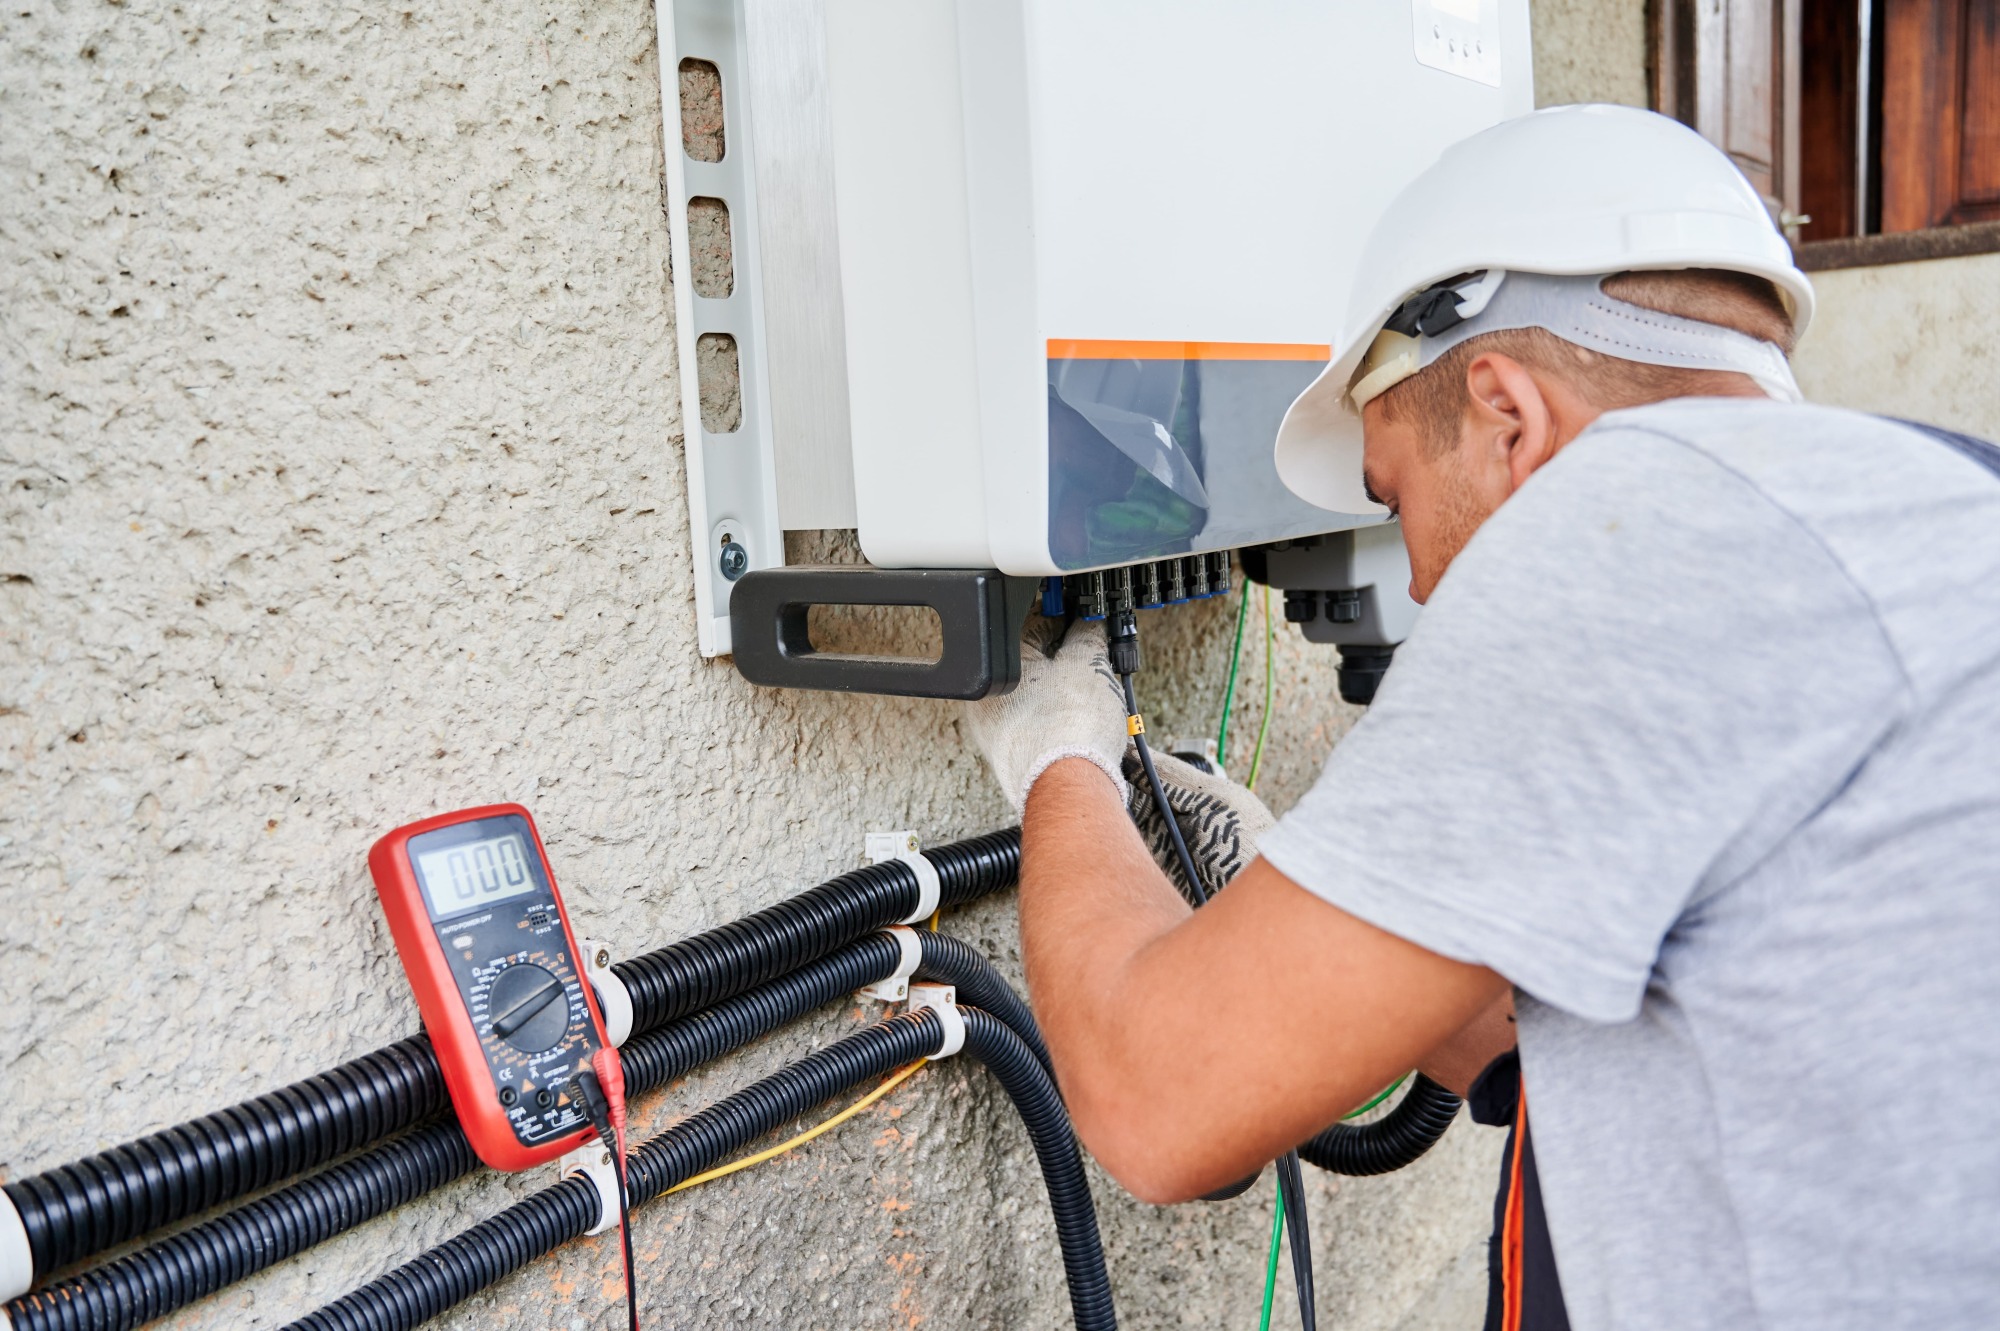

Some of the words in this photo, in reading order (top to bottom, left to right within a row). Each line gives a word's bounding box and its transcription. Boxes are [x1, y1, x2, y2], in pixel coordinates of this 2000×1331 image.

[441, 924, 459, 935] AUTO
[458, 918, 481, 929] POWER
[481, 914, 493, 923] OFF
[498, 1068, 514, 1082] CE
